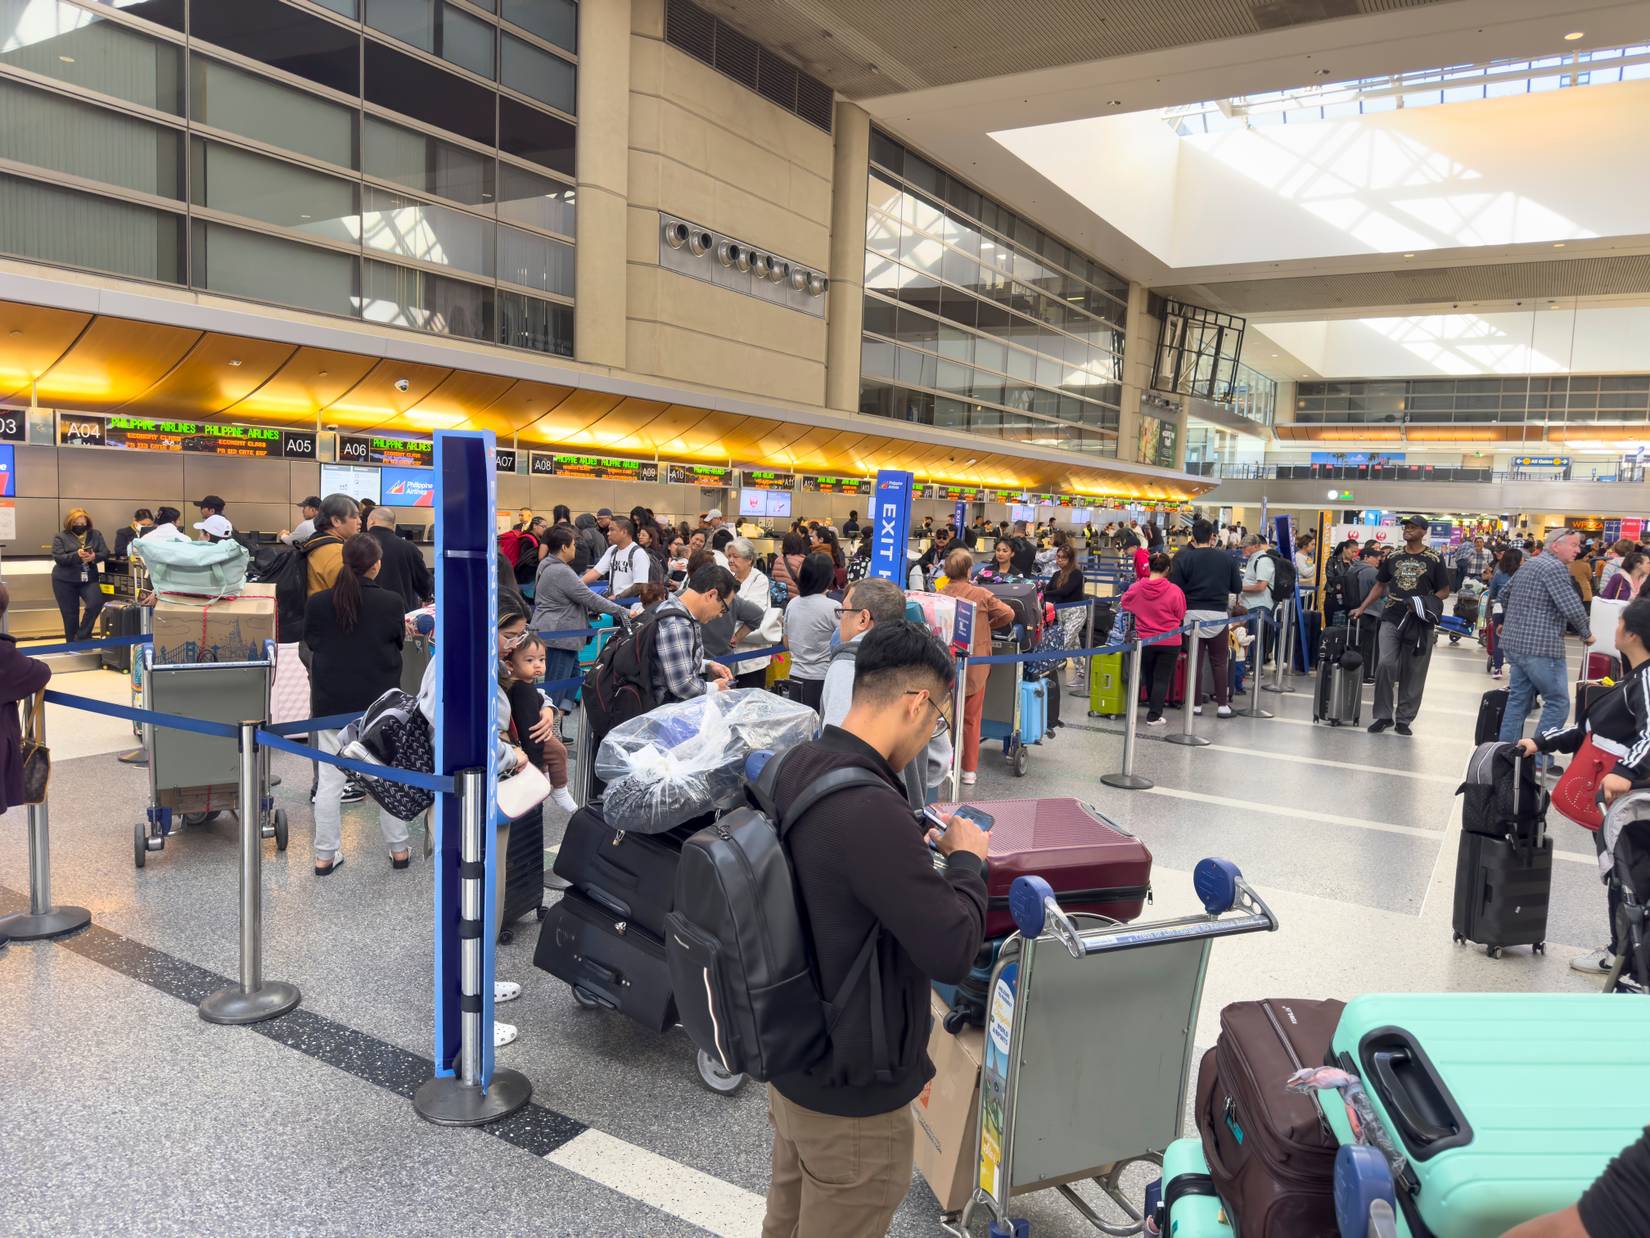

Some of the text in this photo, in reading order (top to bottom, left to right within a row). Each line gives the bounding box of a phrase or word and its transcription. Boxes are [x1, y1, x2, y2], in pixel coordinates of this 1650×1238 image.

[67, 421, 101, 439] A04
[111, 417, 196, 434] PHILIPPINE AIRLINES
[204, 424, 279, 440] PHILIPPINE AIRLINES
[286, 439, 312, 453] A05
[344, 443, 367, 456] A06
[373, 438, 432, 452] PHILIPPINE AIRLINES
[496, 455, 513, 467] A07
[534, 460, 551, 471] A08
[642, 467, 656, 478] A09
[671, 470, 685, 480] A10
[880, 503, 897, 561] EXIT
